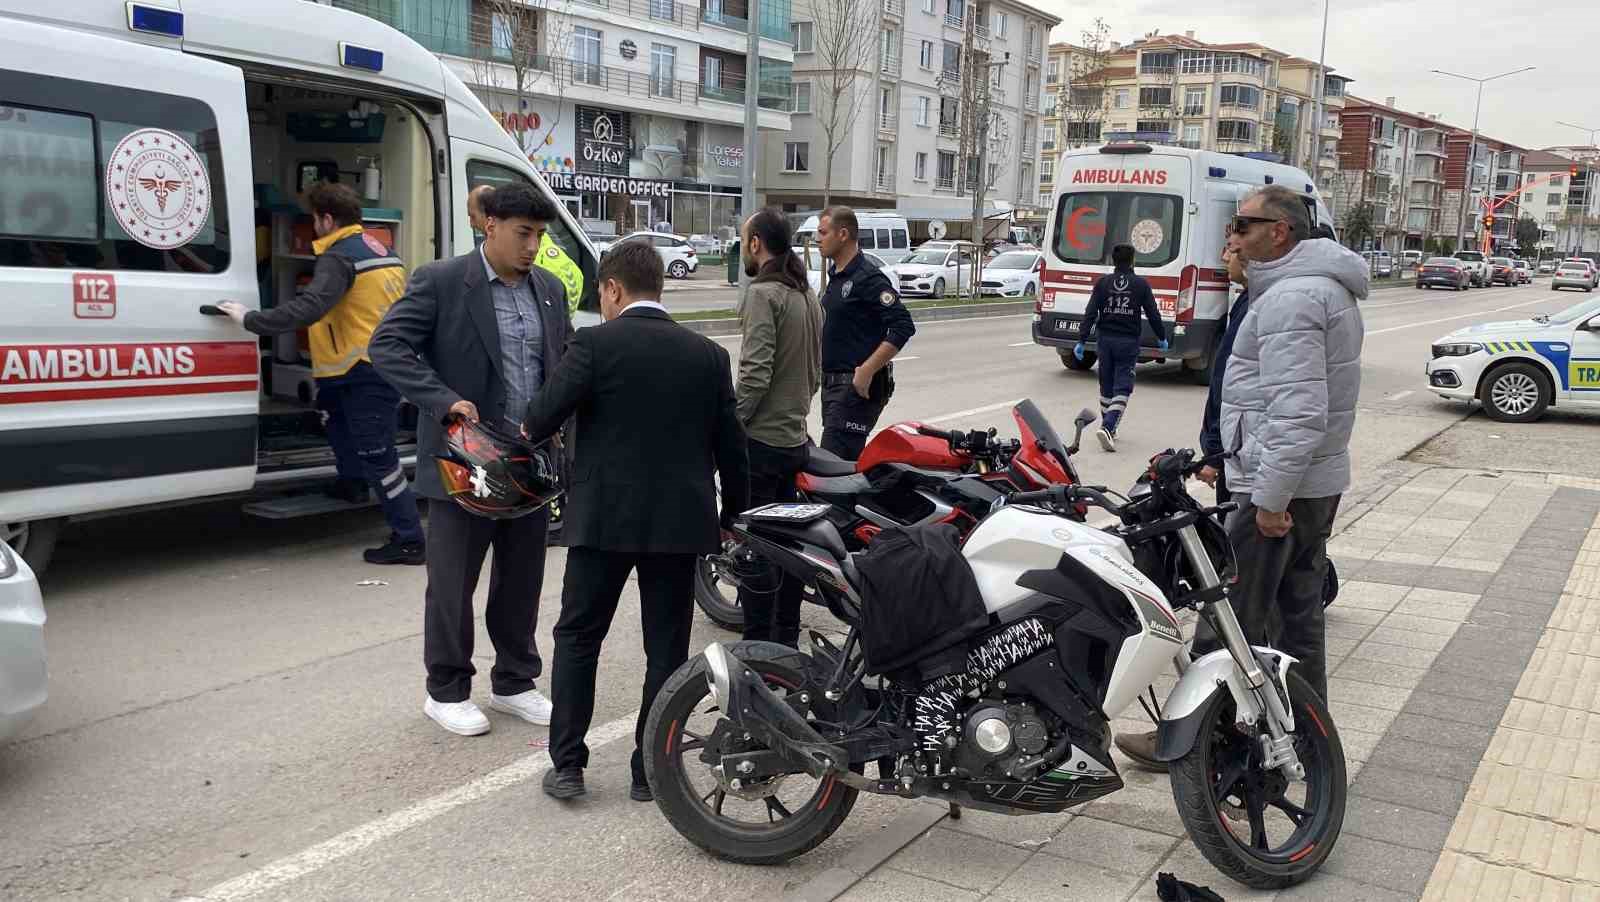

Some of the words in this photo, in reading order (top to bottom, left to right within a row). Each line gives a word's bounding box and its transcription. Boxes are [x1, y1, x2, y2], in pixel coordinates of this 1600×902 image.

[542, 173, 571, 190] OME
[575, 175, 626, 194] GARDEN
[628, 180, 669, 197] OFFICE
[1072, 168, 1168, 185] AMBULANS
[79, 279, 110, 300] 112
[1107, 296, 1130, 308] 112
[1161, 300, 1175, 310] 112
[1, 346, 195, 380] AMBULANS
[1150, 620, 1177, 637] Benelli
